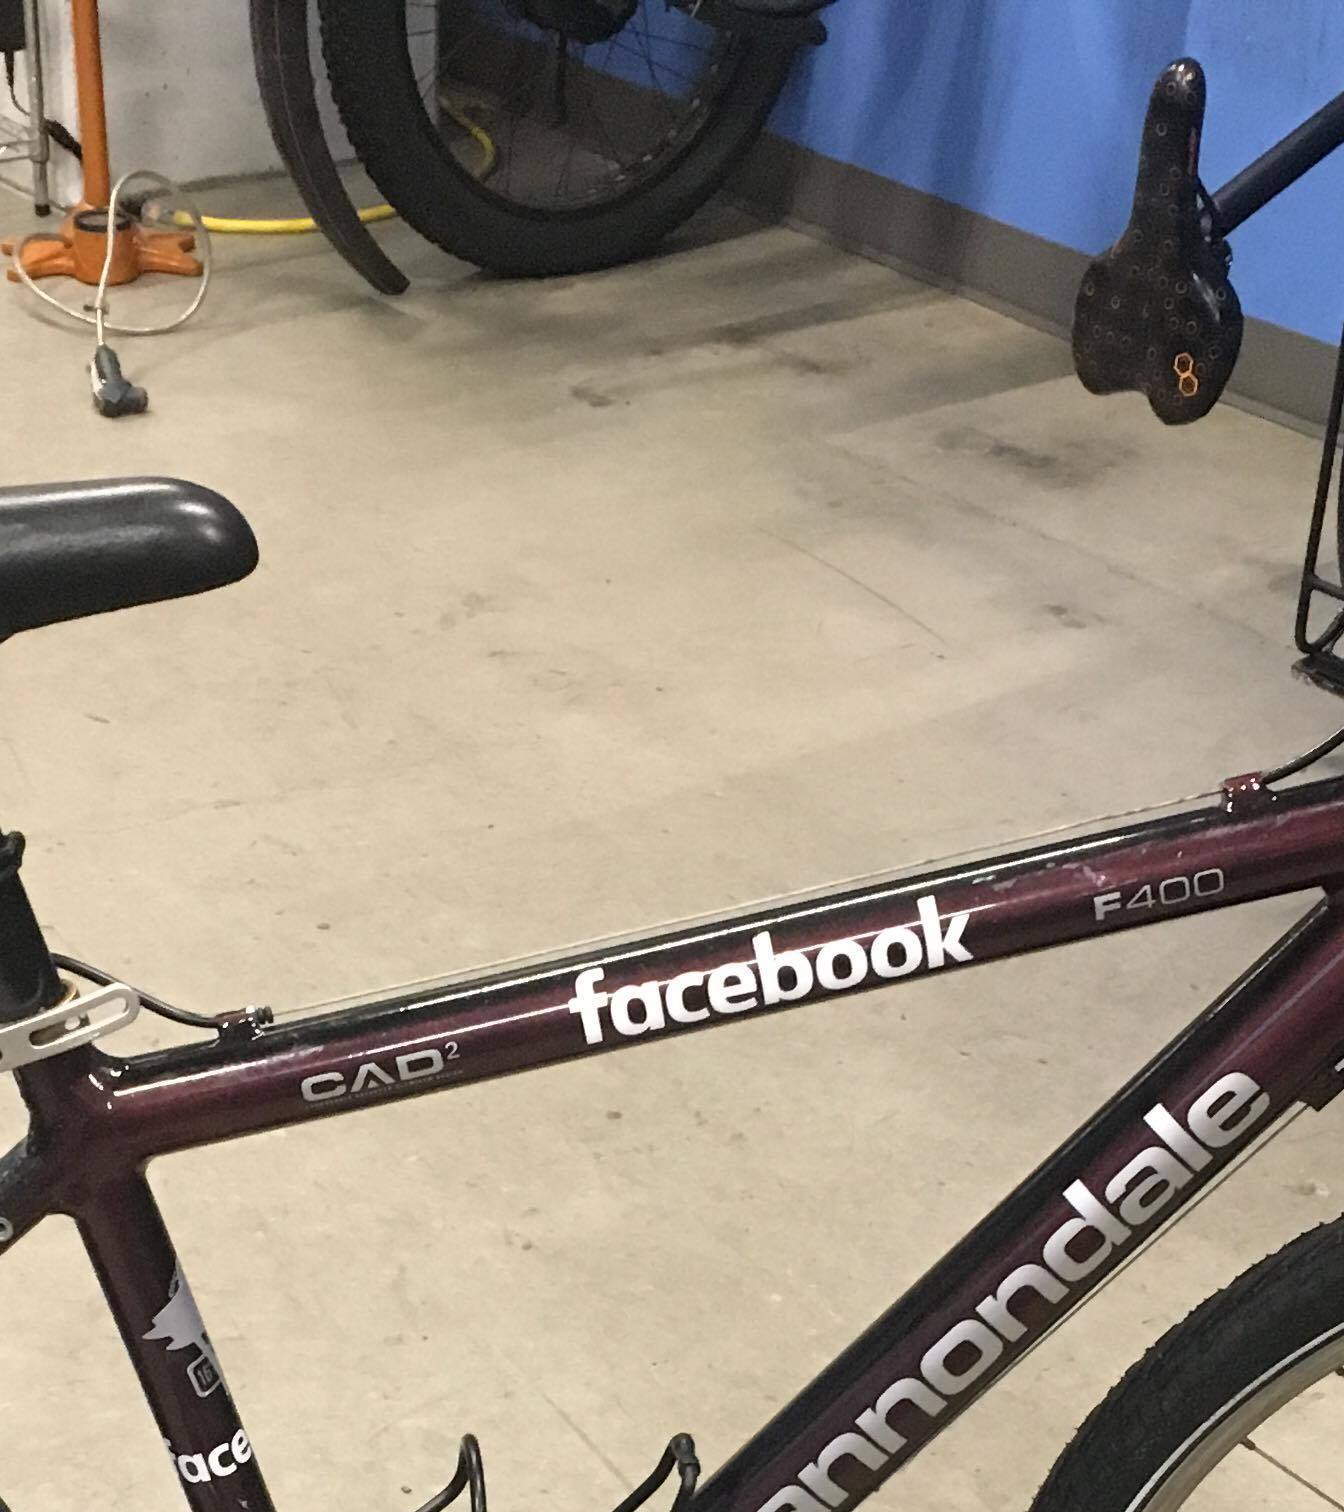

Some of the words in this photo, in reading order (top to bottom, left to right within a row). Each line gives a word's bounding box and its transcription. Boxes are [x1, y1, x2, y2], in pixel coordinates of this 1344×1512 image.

[1093, 868, 1225, 921] F400
[568, 895, 974, 1046] facebook
[164, 1428, 253, 1484] ace
